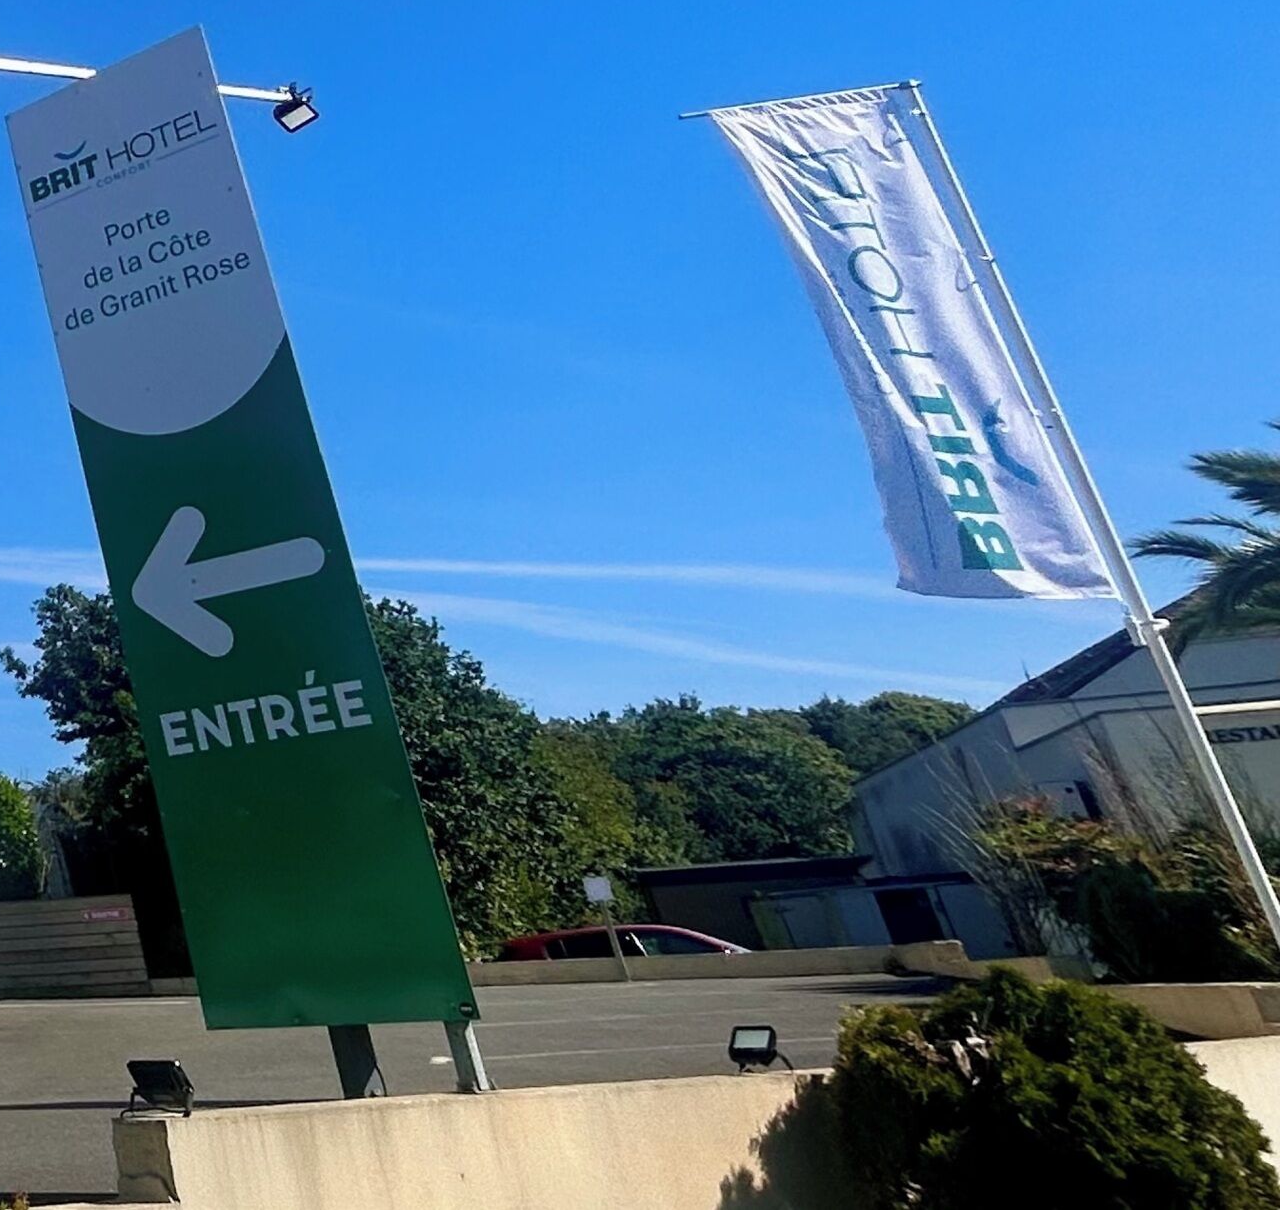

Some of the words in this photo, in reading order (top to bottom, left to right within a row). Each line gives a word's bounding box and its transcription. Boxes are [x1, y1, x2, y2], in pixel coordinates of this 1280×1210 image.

[29, 154, 98, 203] BRIT
[106, 110, 217, 169] HOTEL
[96, 160, 153, 188] CONFORT
[83, 267, 114, 289] de
[118, 255, 143, 276] la
[147, 229, 212, 263] Côte
[103, 208, 171, 246] Porte
[64, 308, 95, 331] de
[100, 275, 179, 318] Granit
[182, 251, 251, 289] Rose
[159, 670, 374, 757] ENTRÉE
